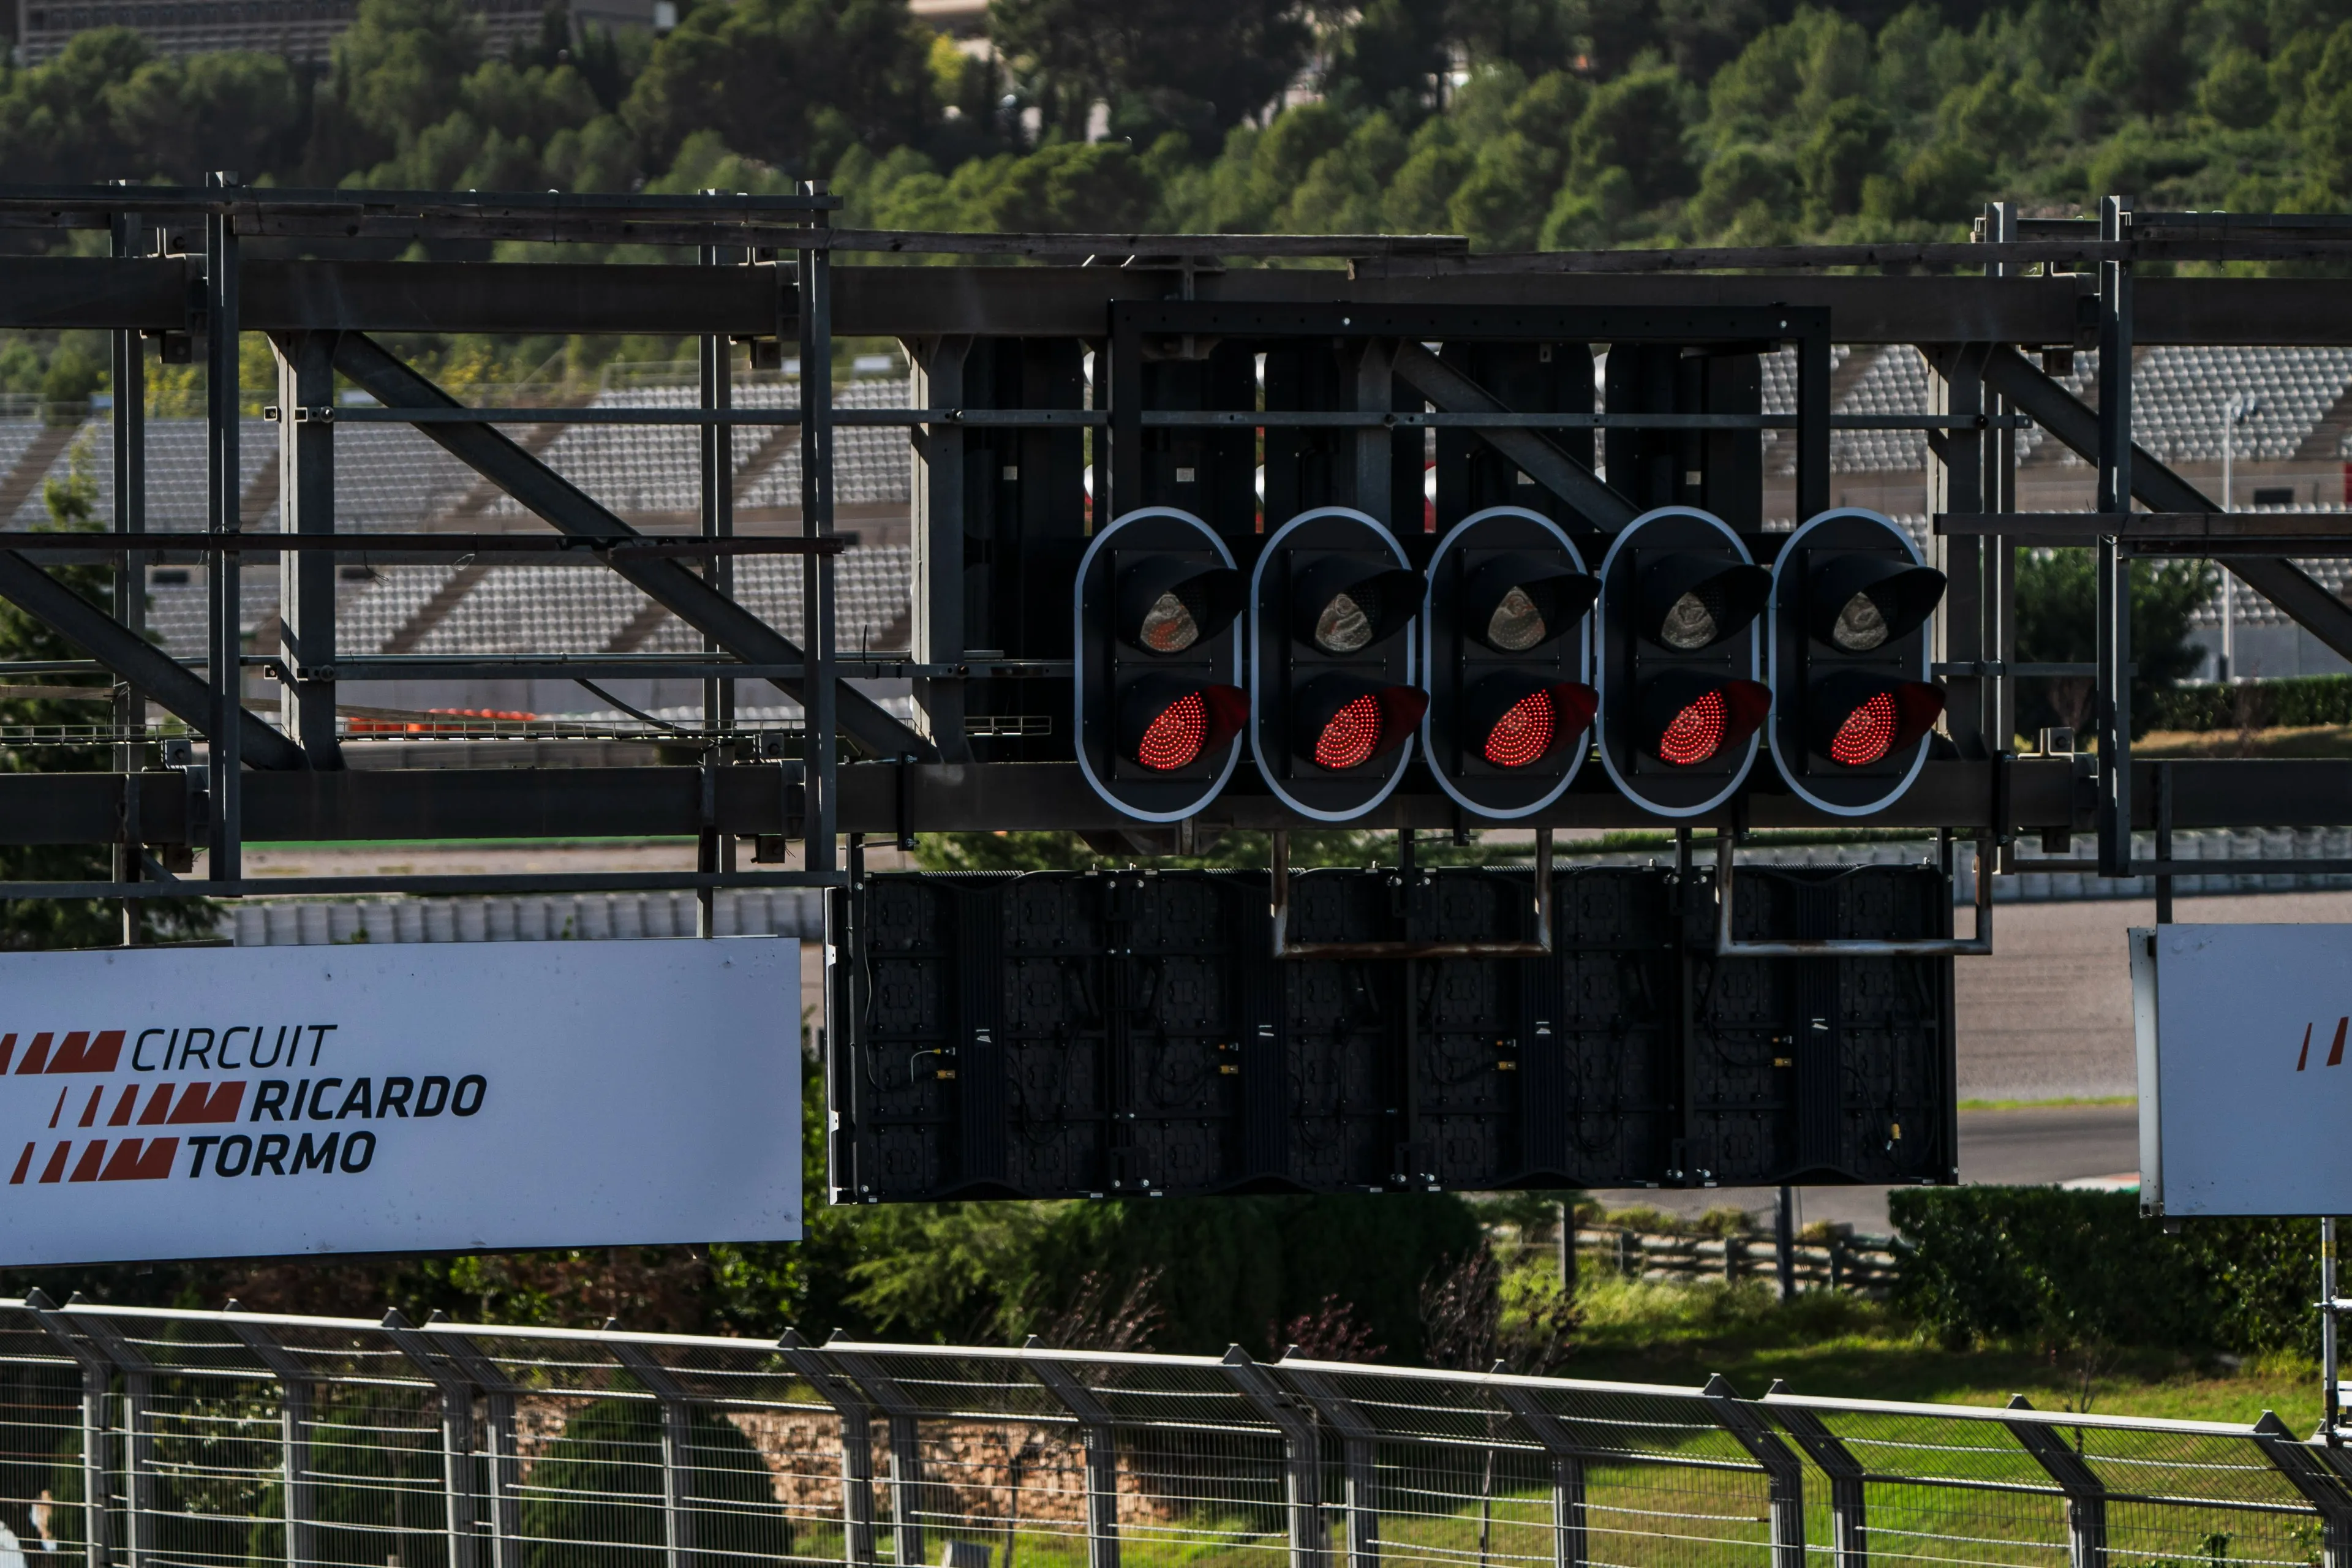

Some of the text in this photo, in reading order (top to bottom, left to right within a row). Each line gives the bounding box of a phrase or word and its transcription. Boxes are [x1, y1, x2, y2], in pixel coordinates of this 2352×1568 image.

[131, 1024, 338, 1071] CIRCUIT
[249, 1074, 488, 1122] RICARDO
[187, 1130, 377, 1178] TORMO
